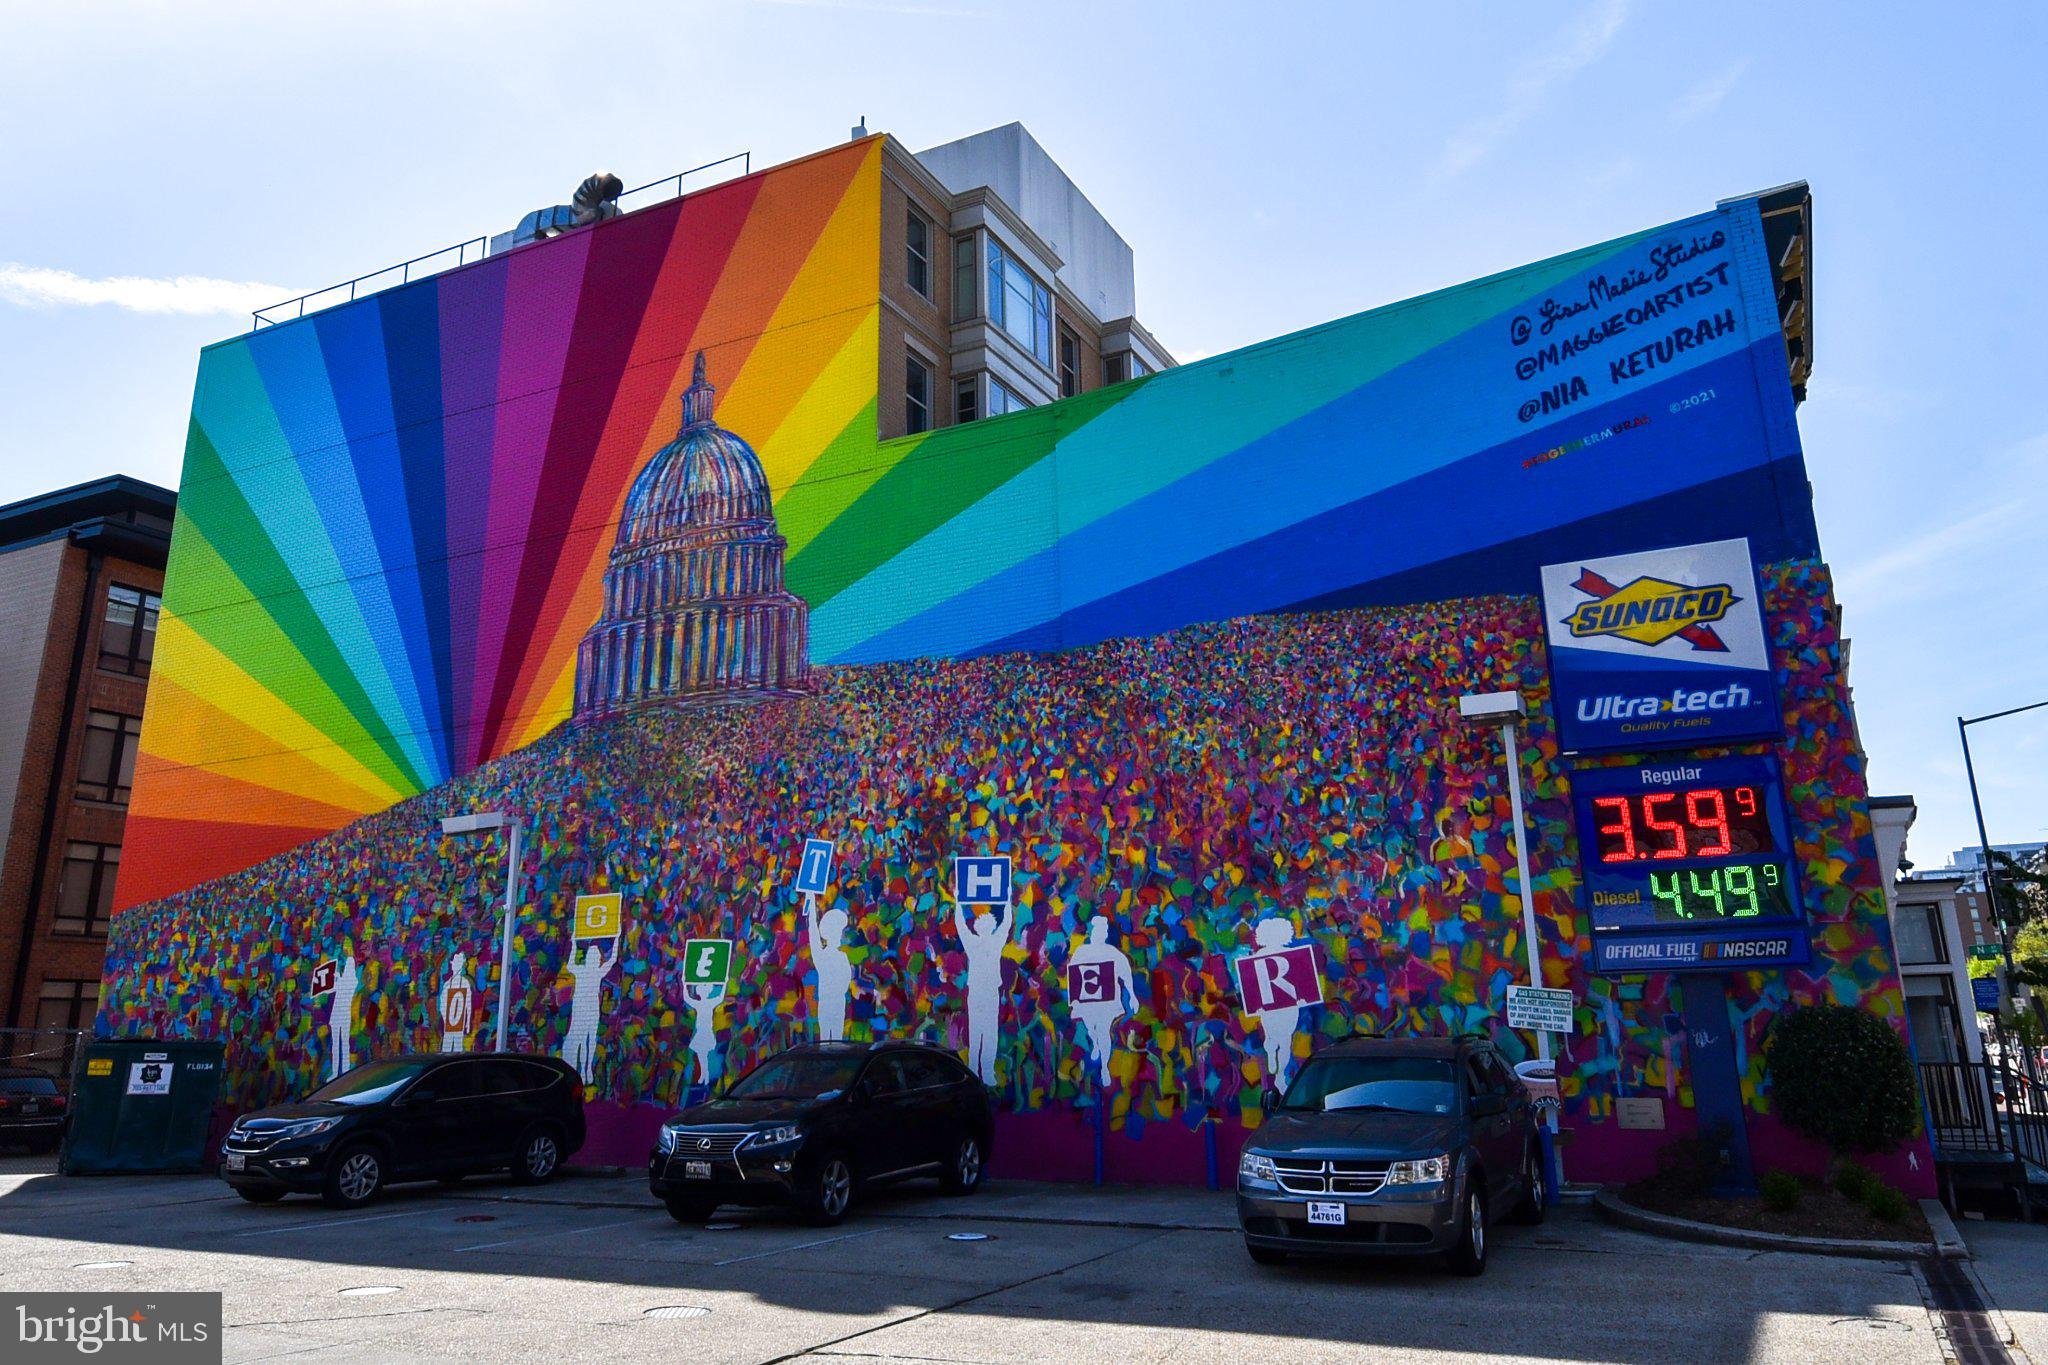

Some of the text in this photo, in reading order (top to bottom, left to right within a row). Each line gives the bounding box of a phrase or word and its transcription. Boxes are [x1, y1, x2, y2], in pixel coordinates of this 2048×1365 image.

[1588, 270, 1653, 309] Marie
[1650, 230, 1725, 281] Studio
[1515, 262, 1729, 380] @MAGGIEOARTIST
[1518, 308, 1736, 423] @NIA KETURAH
[1576, 590, 1724, 632] SUNOCO
[1620, 717, 1712, 733] Quality Fuels
[1641, 766, 1702, 785] Regular
[1593, 889, 1641, 907] Diesel
[317, 846, 1298, 1027] T O G E T H E R
[1605, 944, 1663, 959] OFFICIAL
[1666, 942, 1699, 957] FUEL
[1723, 940, 1788, 958] NASCAR
[1311, 1212, 1341, 1222] 44761G
